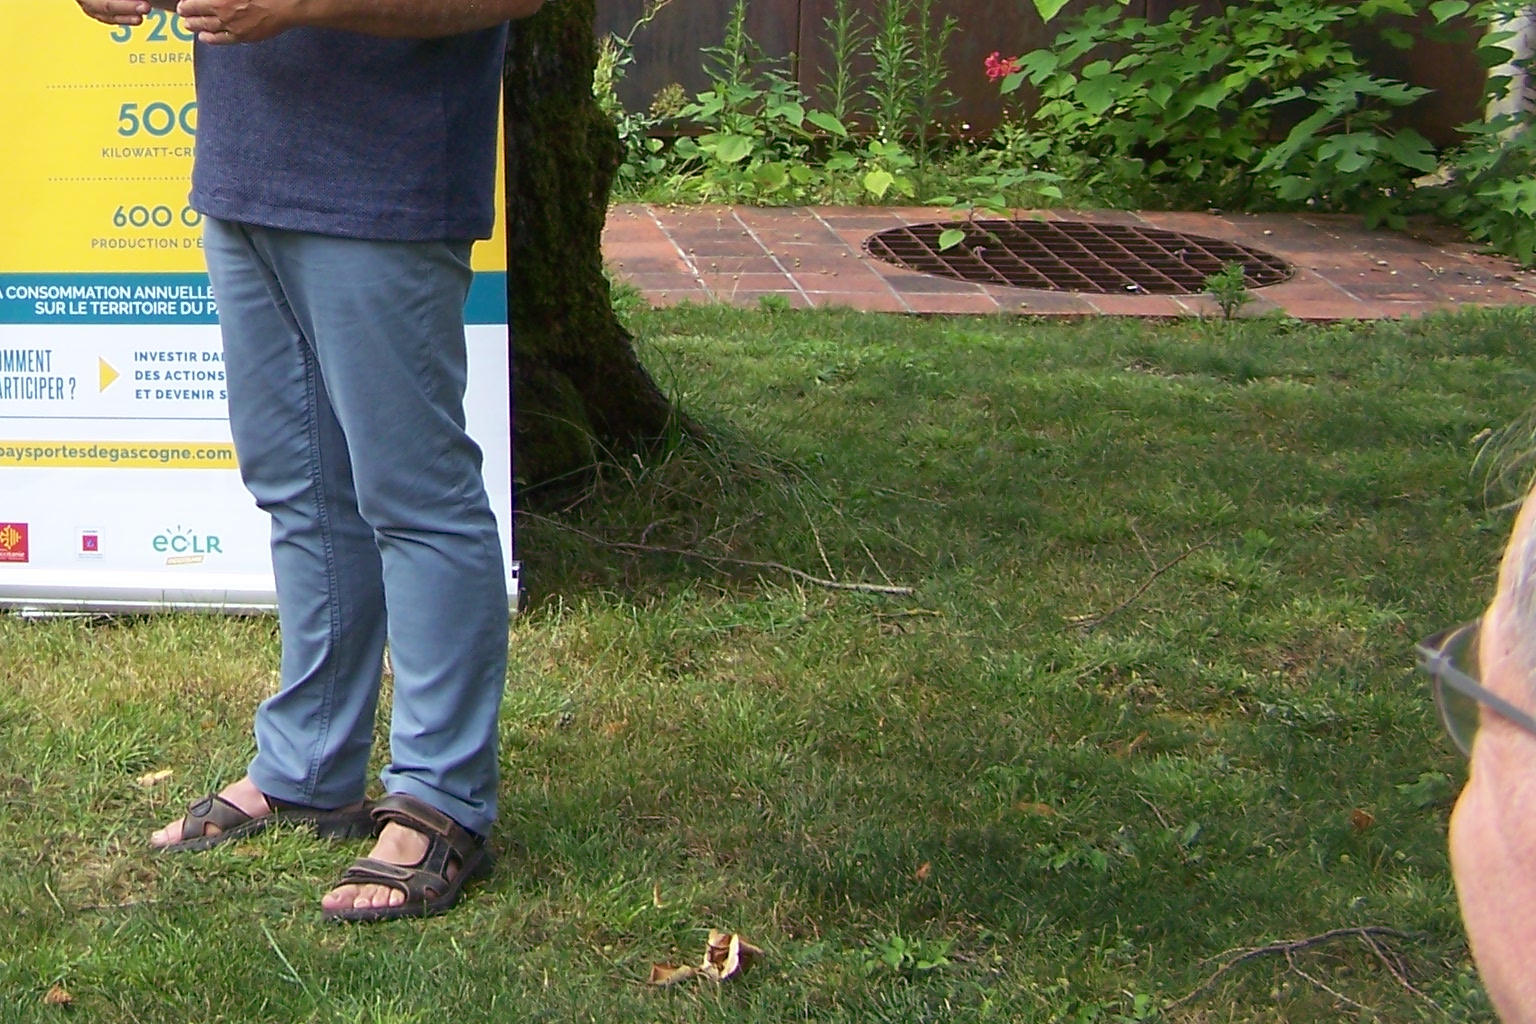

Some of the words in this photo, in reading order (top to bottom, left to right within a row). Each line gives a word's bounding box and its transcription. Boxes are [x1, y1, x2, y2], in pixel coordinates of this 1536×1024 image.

[129, 53, 146, 64] DE
[113, 205, 172, 228] 600
[91, 237, 178, 250] PRODUCTION
[5, 285, 132, 300] CONSOMMATION
[133, 285, 214, 300] ANNUELLE
[34, 301, 66, 316] SUR
[69, 301, 88, 315] LE
[90, 301, 175, 316] TERRITOIRE
[180, 301, 203, 315] DU
[134, 351, 197, 363] INVESTIR
[135, 370, 161, 381] DES
[164, 370, 225, 382] ACTIONS
[135, 389, 152, 400] ET
[156, 389, 214, 400] DEVENIR
